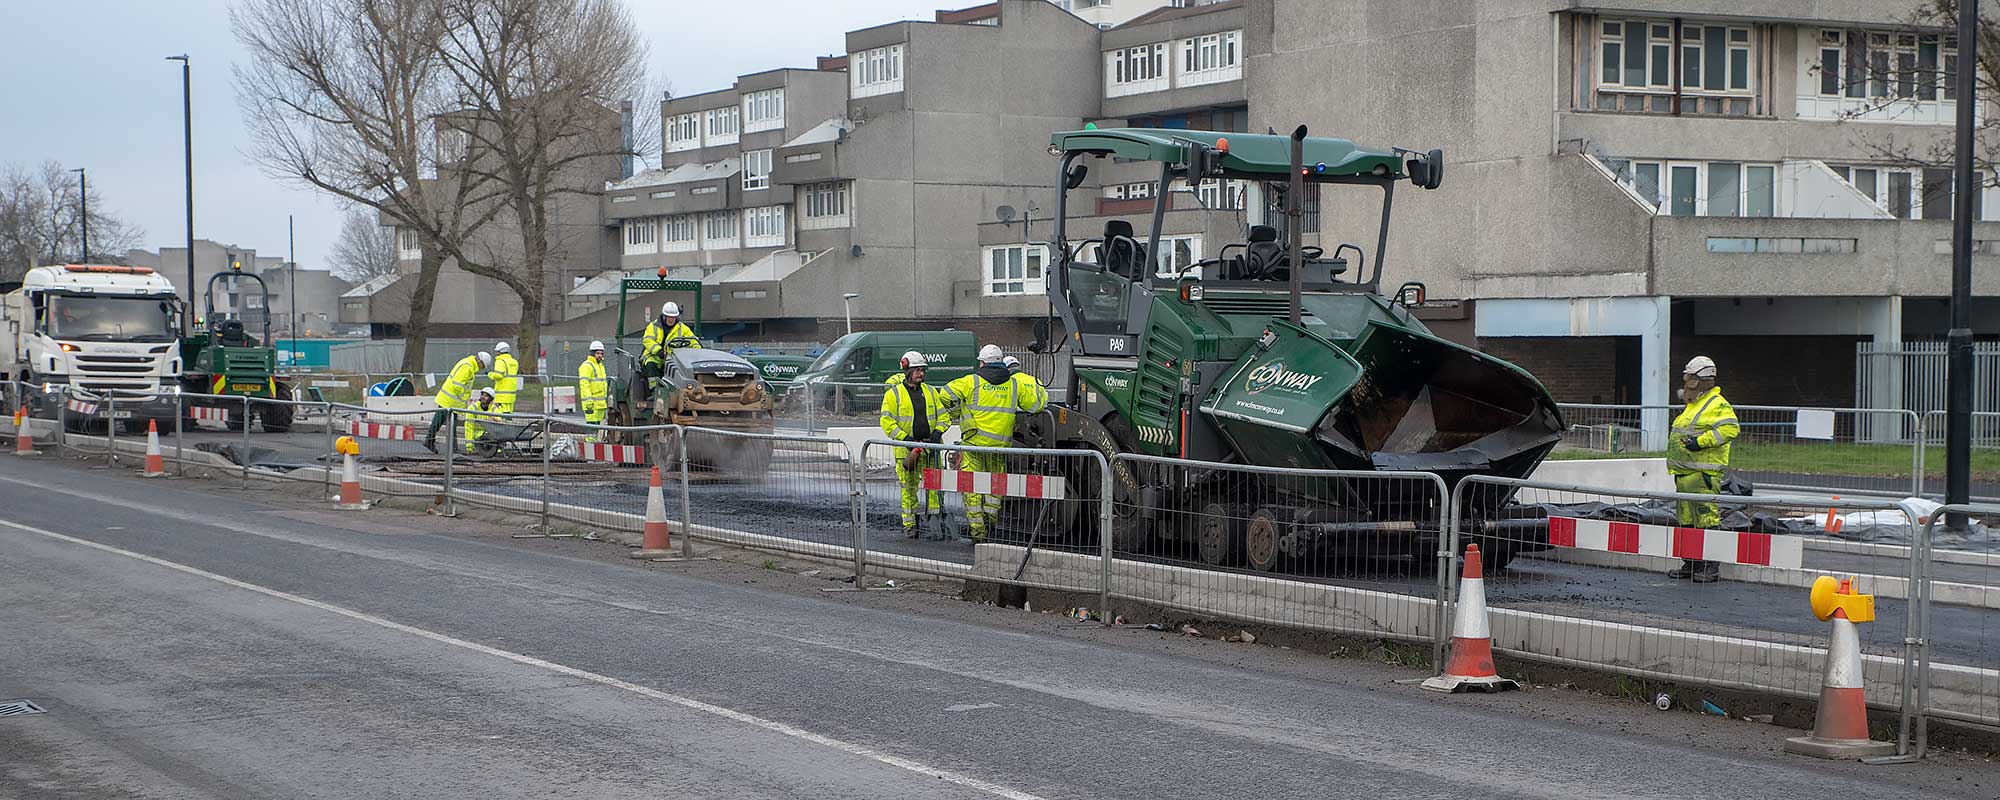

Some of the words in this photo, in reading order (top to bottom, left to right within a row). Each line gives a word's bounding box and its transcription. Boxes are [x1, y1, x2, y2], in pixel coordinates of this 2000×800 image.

[1109, 338, 1125, 351] PA9
[922, 353, 948, 363] WAY
[764, 363, 799, 375] CONWAY
[1105, 375, 1129, 388] CONWAY
[1248, 363, 1323, 390] CONWAY
